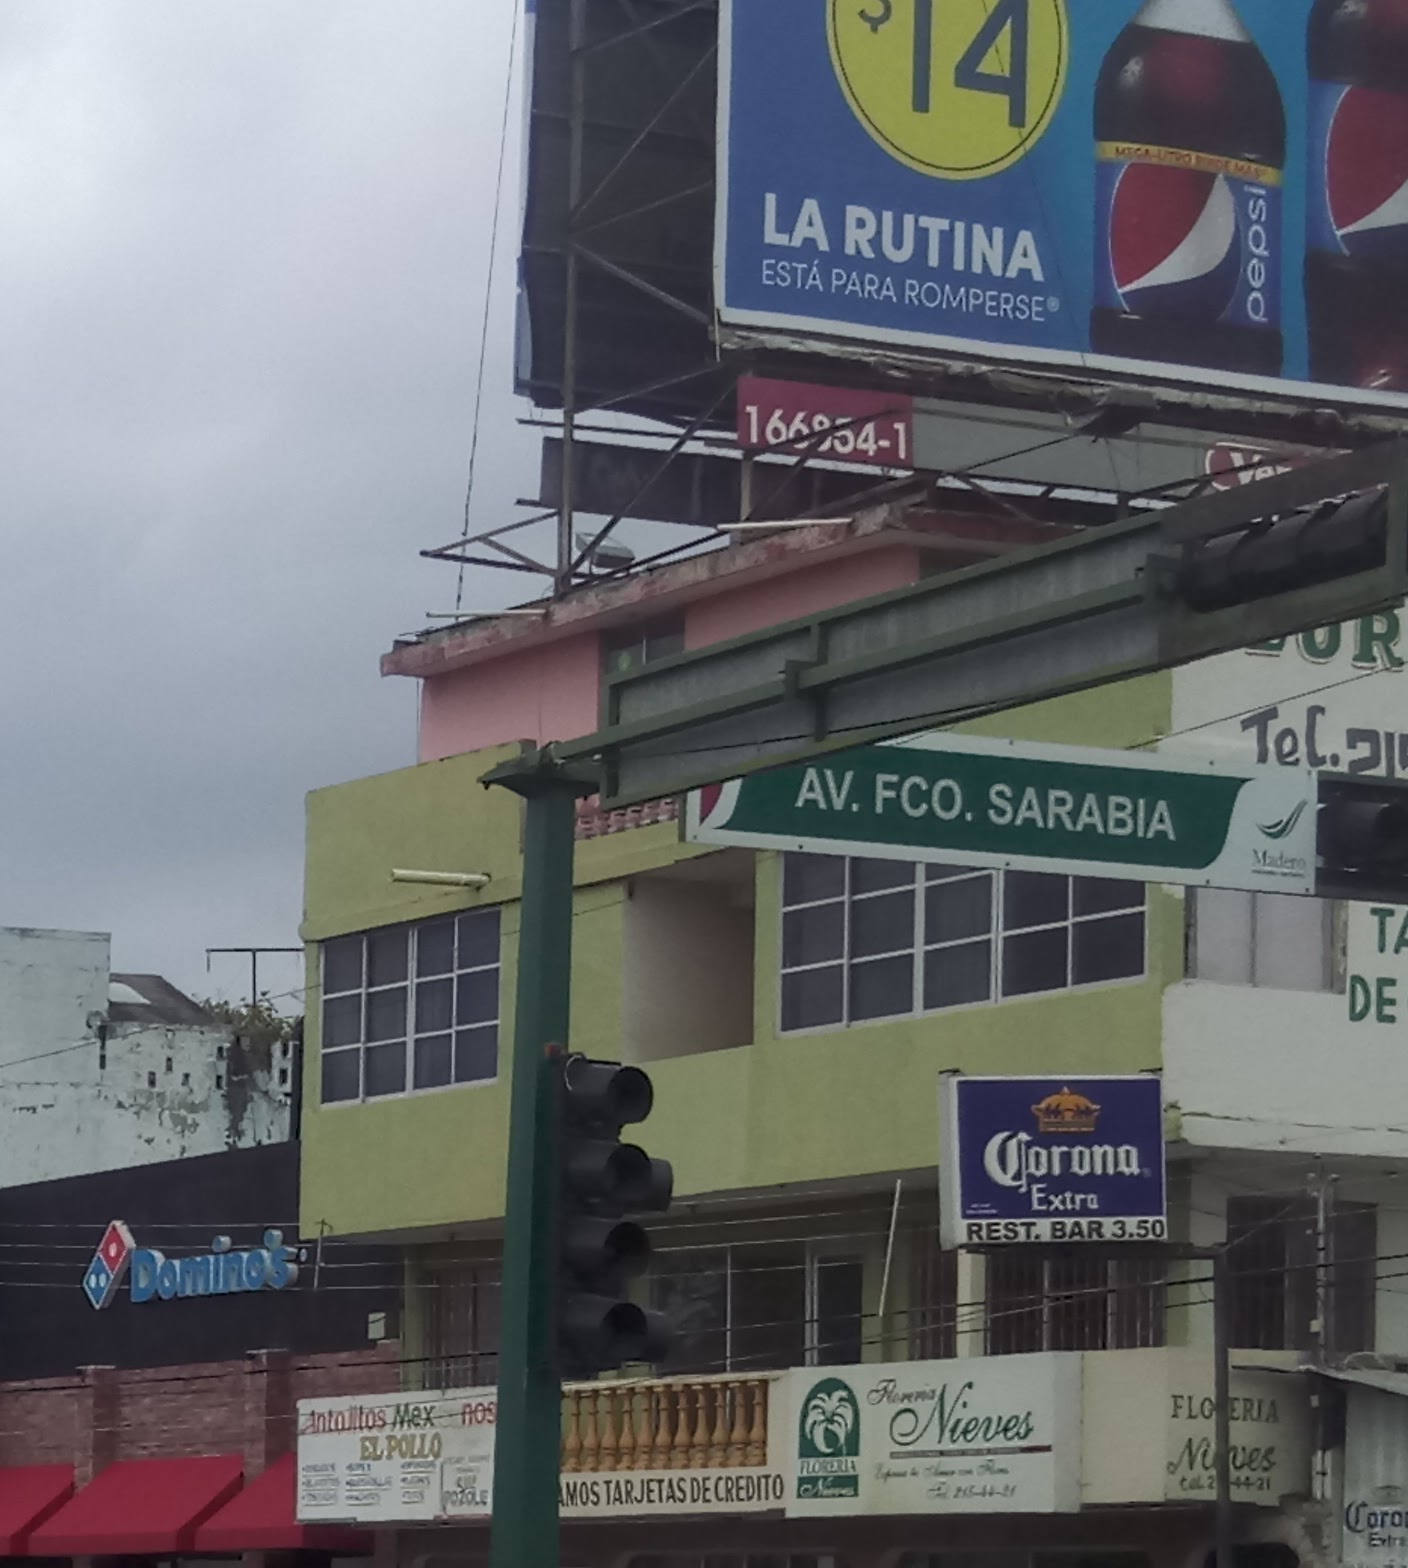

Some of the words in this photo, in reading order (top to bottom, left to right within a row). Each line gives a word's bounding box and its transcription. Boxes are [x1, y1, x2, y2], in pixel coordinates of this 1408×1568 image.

[764, 192, 830, 252] LA
[844, 204, 1045, 282] RUTINA
[1243, 184, 1270, 323] pepsi
[761, 257, 824, 293] ESTÁ
[831, 268, 898, 304] PARA
[795, 767, 860, 813] AV.
[875, 774, 973, 822] FCO.
[987, 783, 1177, 842] SARABIA
[1349, 974, 1398, 1024] DE
[983, 1130, 1141, 1193] Corona
[1031, 1183, 1100, 1212] Extra
[966, 1221, 1041, 1242] REST.
[1050, 1219, 1105, 1241] BAR
[1112, 1218, 1166, 1240] 3.50
[889, 1381, 1035, 1447] Nieves
[1170, 1393, 1280, 1423] FLOERIA
[359, 1435, 384, 1461] EL
[385, 1432, 443, 1461] POLLO
[1166, 1436, 1277, 1475] Nives
[603, 1477, 687, 1507] TARJETAS
[690, 1475, 712, 1504] DE
[714, 1474, 784, 1504] CREDITO
